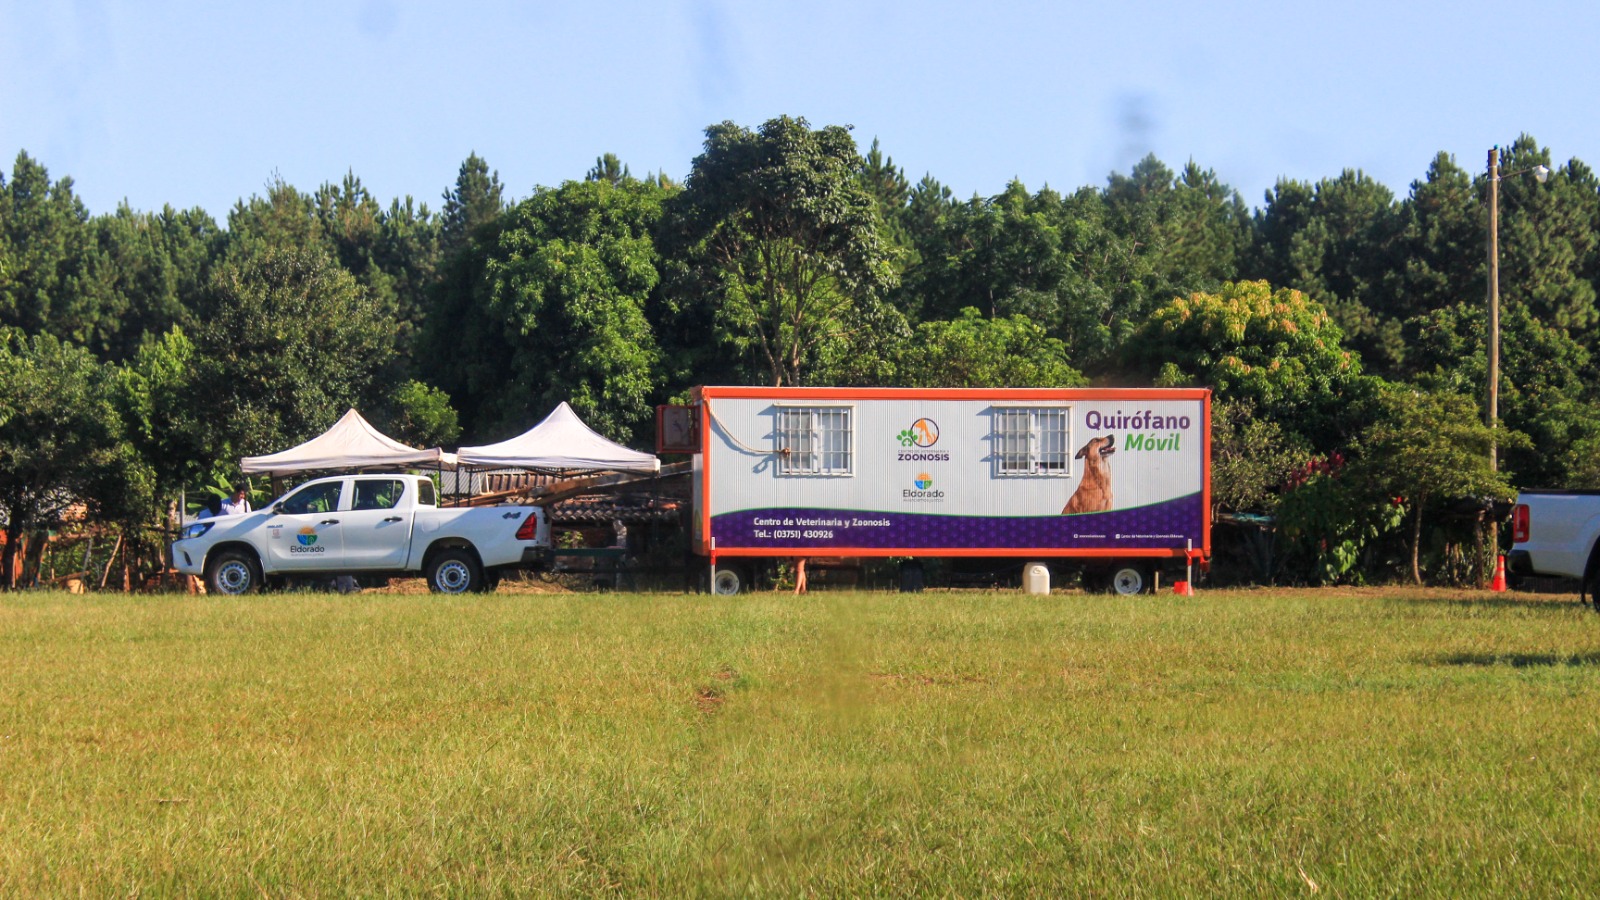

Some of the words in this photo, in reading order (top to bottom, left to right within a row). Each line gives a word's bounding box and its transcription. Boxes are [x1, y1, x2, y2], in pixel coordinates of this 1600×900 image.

[1085, 410, 1191, 431] Quirófano
[1124, 433, 1181, 451] Móvil
[897, 453, 950, 461] ZOONOSIS
[902, 489, 945, 498] Eldorado
[753, 517, 781, 526] Centro
[783, 517, 794, 526] de
[796, 517, 843, 526] Veterinaria
[844, 519, 850, 528] y
[852, 518, 891, 527] Zoonosis
[773, 530, 801, 539] (03751)
[803, 530, 834, 539] 430926
[290, 545, 325, 553] Eldorado
